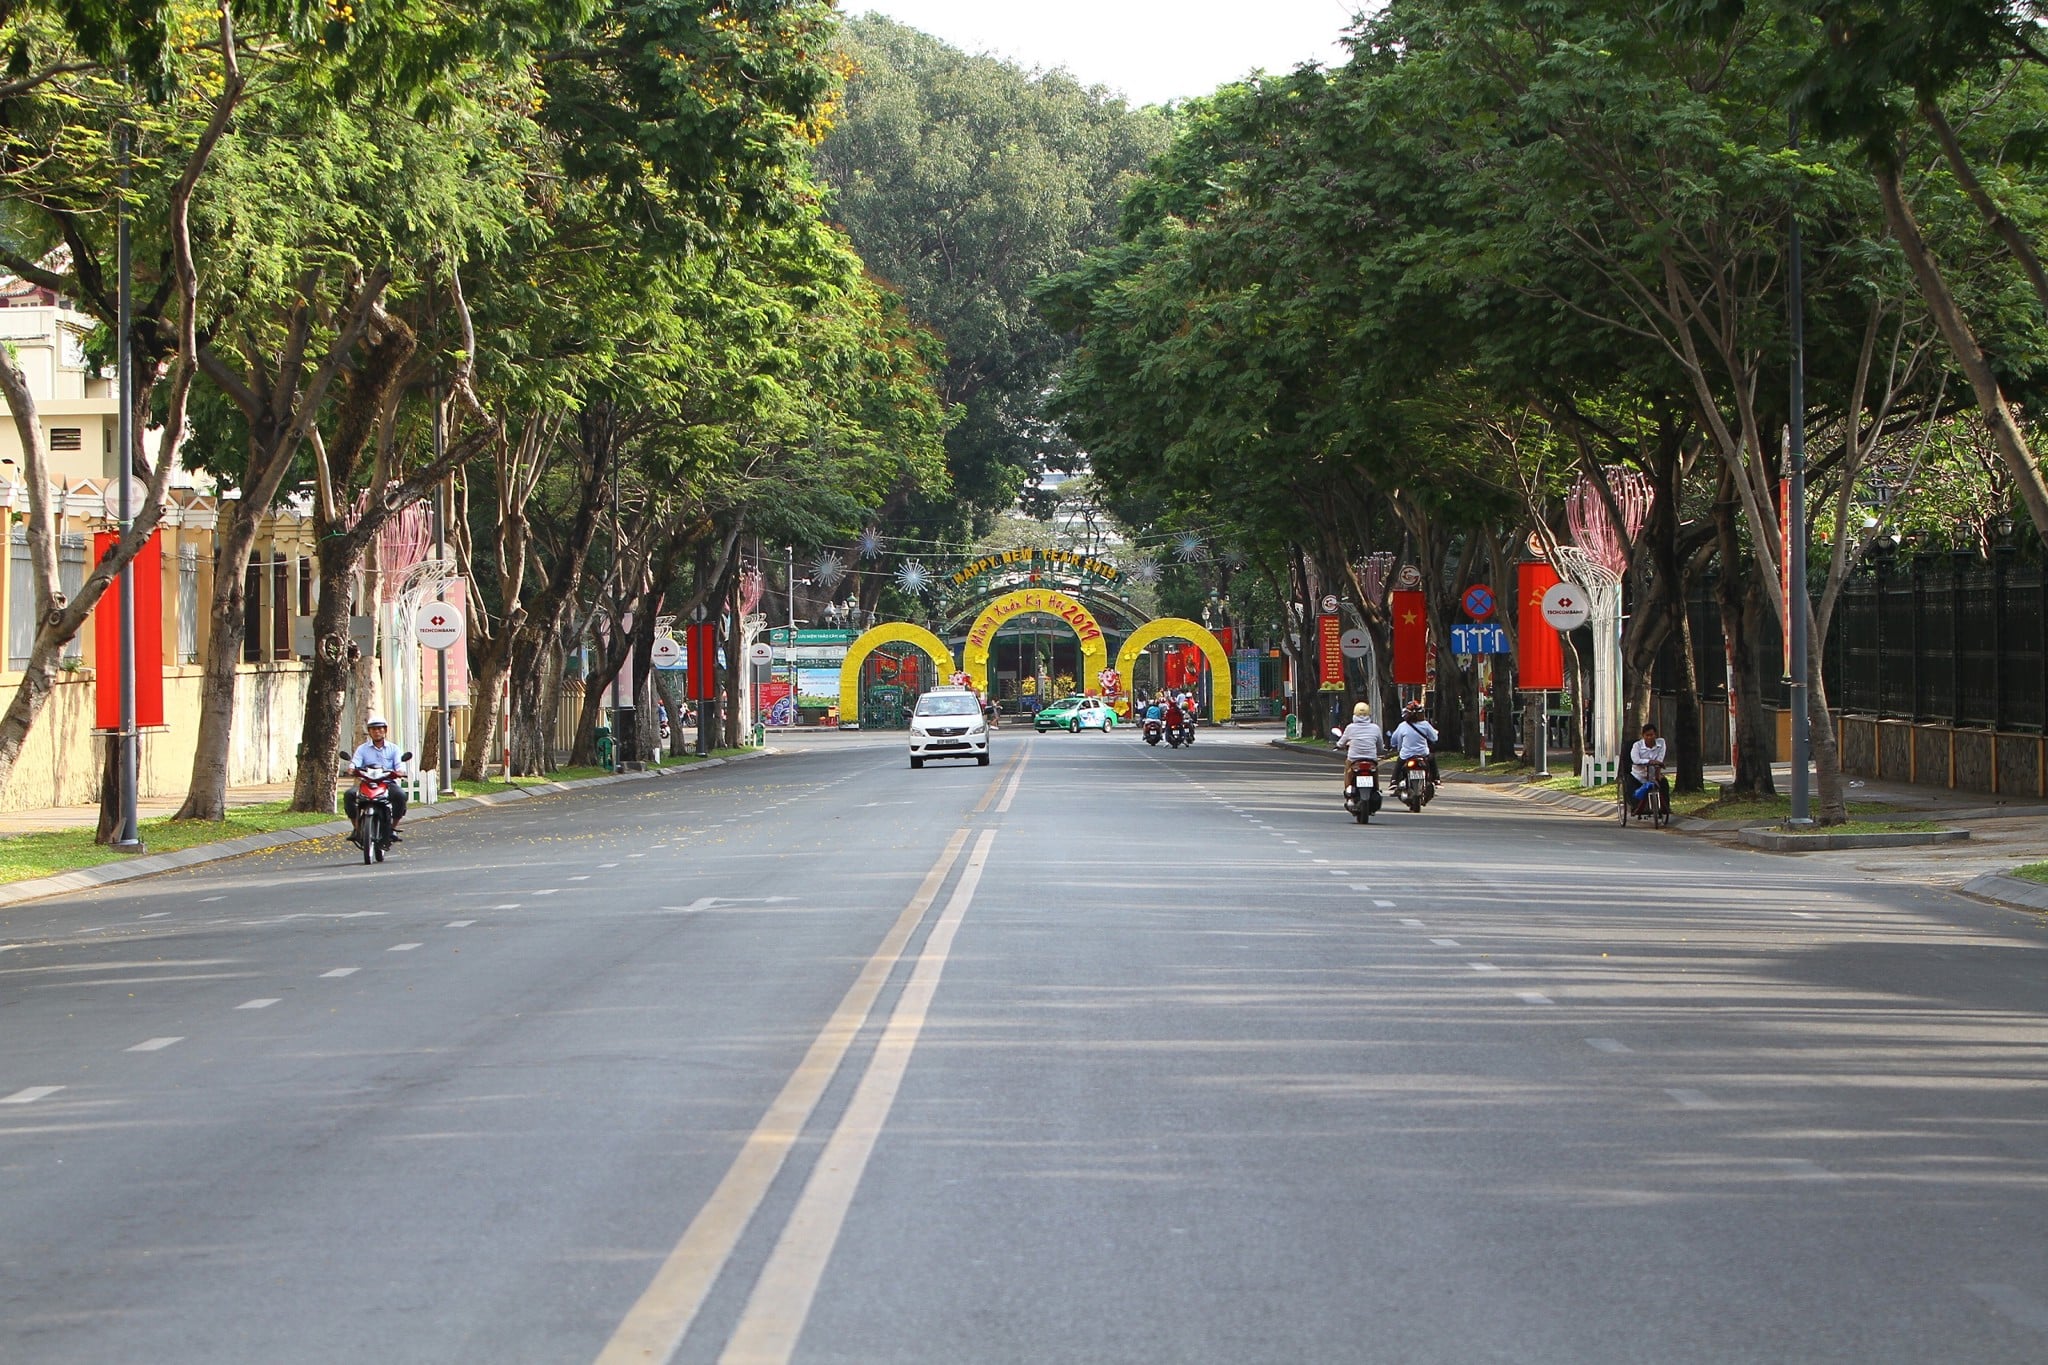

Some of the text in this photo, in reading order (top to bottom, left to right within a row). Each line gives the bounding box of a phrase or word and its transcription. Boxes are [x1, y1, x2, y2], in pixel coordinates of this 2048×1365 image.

[952, 556, 996, 585] HAPPY
[1001, 548, 1033, 565] NEW
[1042, 549, 1080, 567] YEAR
[1084, 557, 1117, 580] 2019
[1062, 605, 1100, 641] 2019
